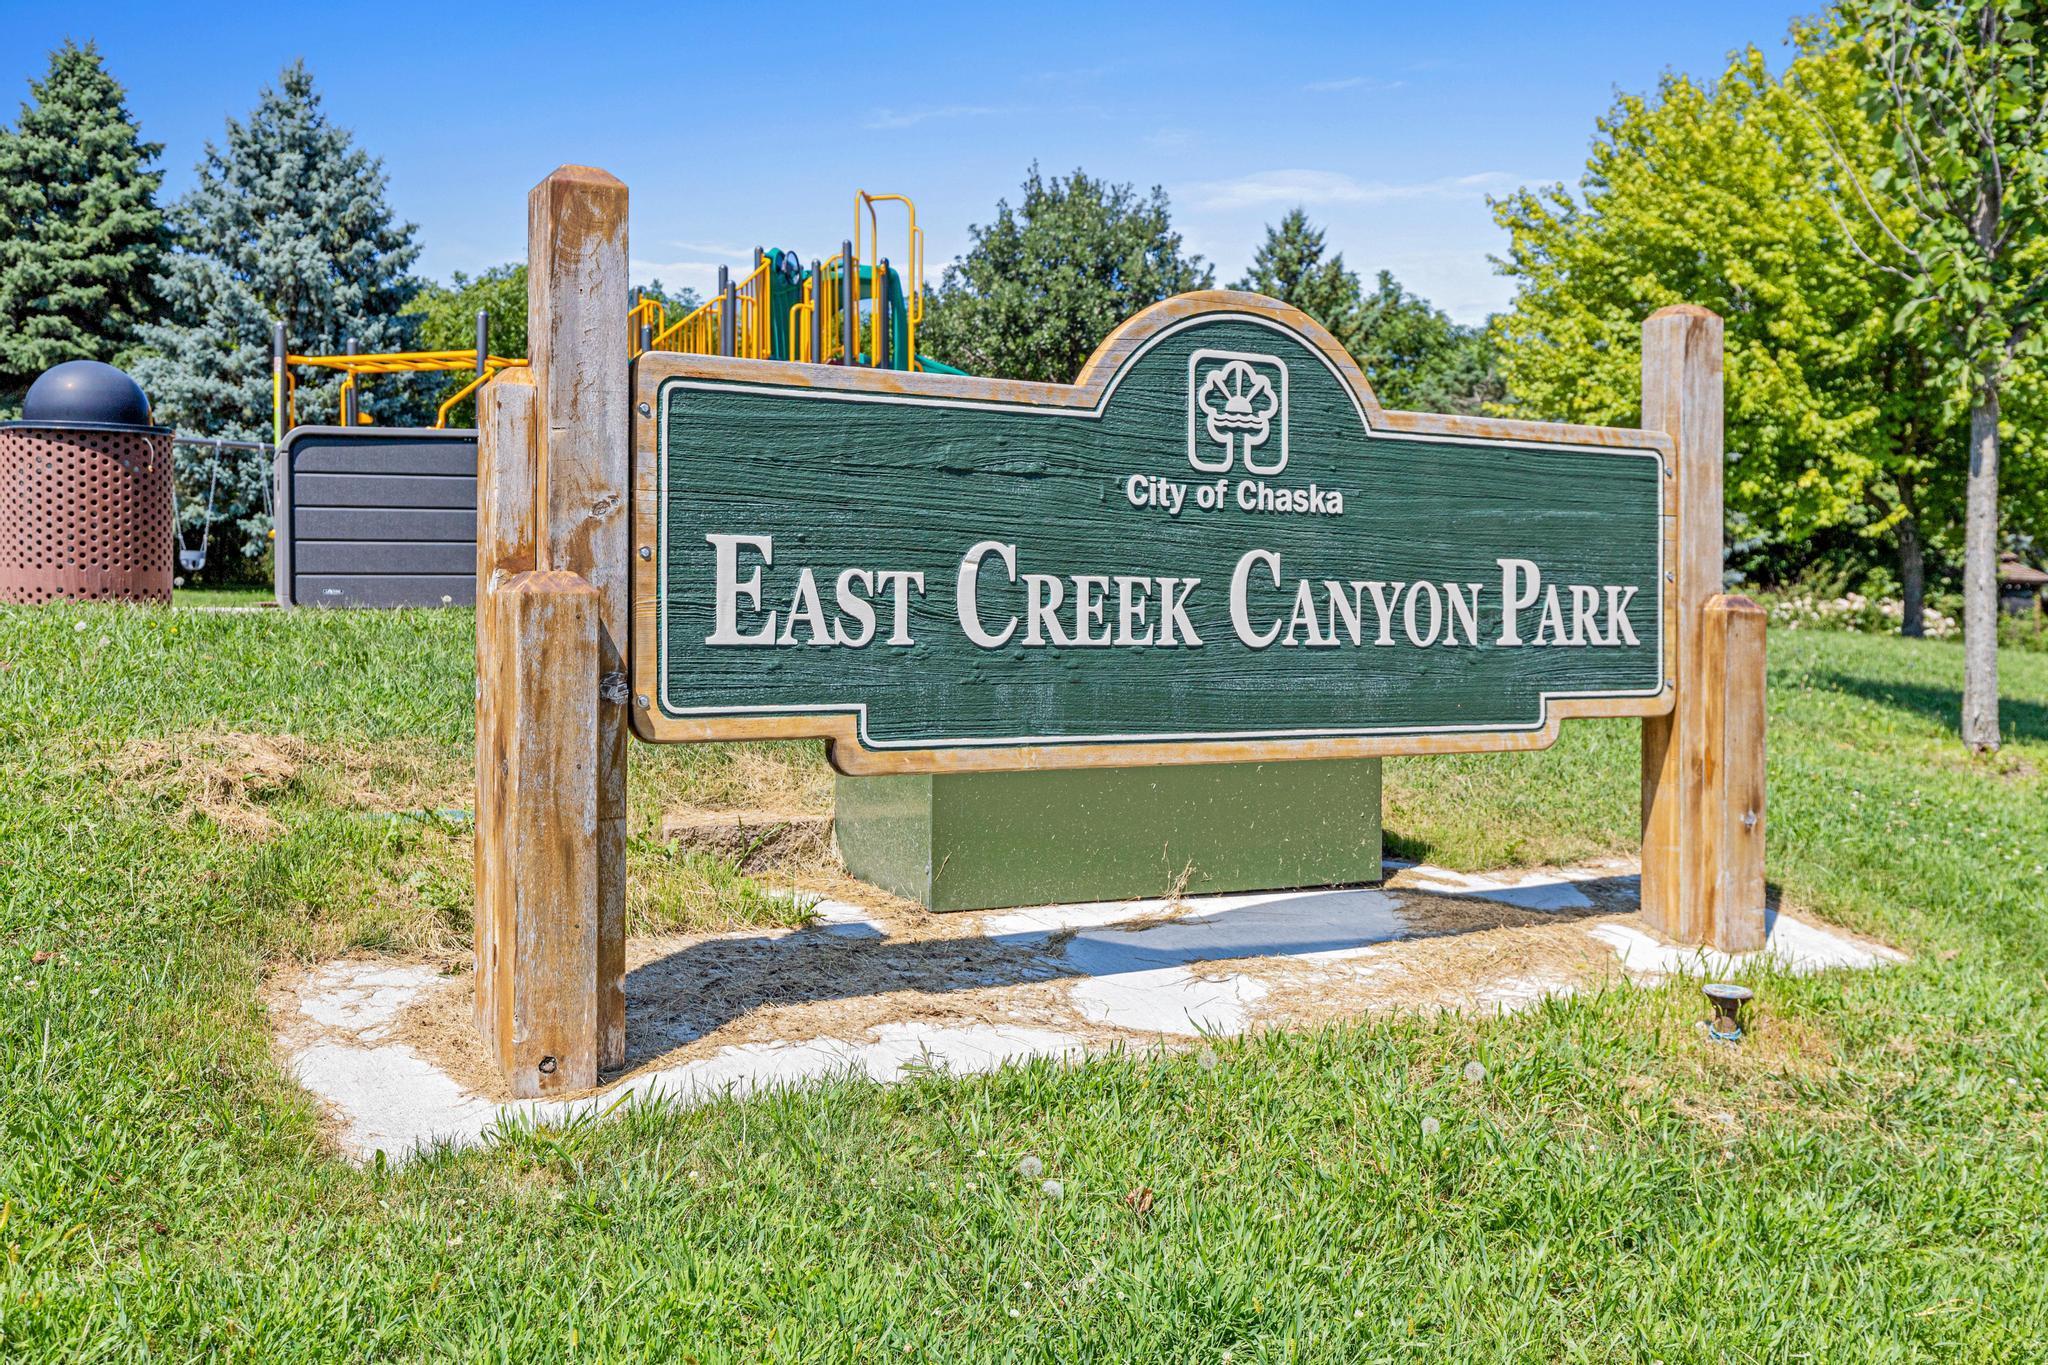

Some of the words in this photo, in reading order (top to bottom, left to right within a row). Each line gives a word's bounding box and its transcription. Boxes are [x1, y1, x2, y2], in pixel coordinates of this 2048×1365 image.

[1126, 473, 1187, 516] City
[1194, 478, 1229, 509] of
[1236, 480, 1344, 514] Chaska
[704, 532, 926, 648] EAST
[956, 541, 1204, 649] CREEK
[1229, 548, 1485, 648] CANYON
[1496, 558, 1641, 648] PARK
